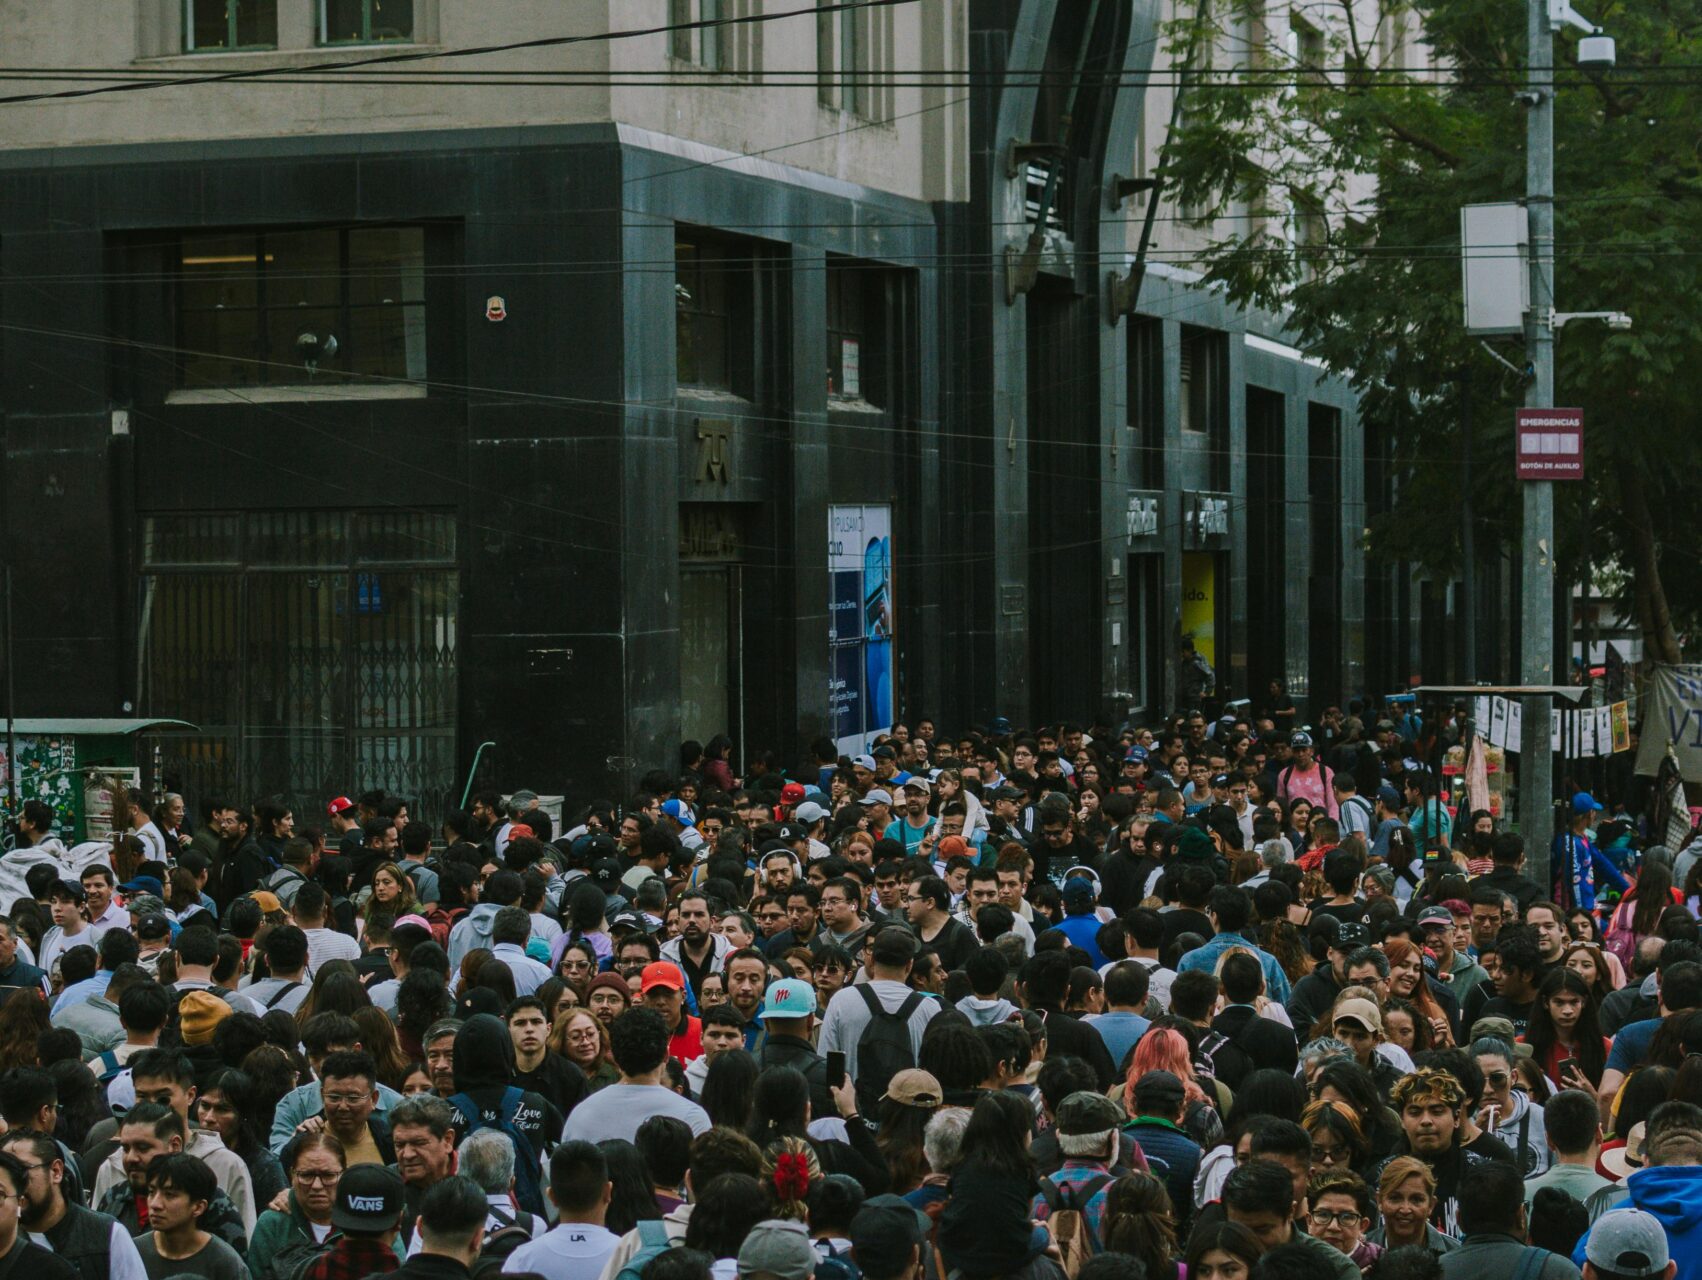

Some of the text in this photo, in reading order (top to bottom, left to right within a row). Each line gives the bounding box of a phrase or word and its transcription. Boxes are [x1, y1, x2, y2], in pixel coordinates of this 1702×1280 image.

[1520, 418, 1580, 427] EMERGENCIAS
[1520, 461, 1543, 470] BOTÓN
[513, 1101, 542, 1121] Love
[347, 1193, 385, 1212] VANS
